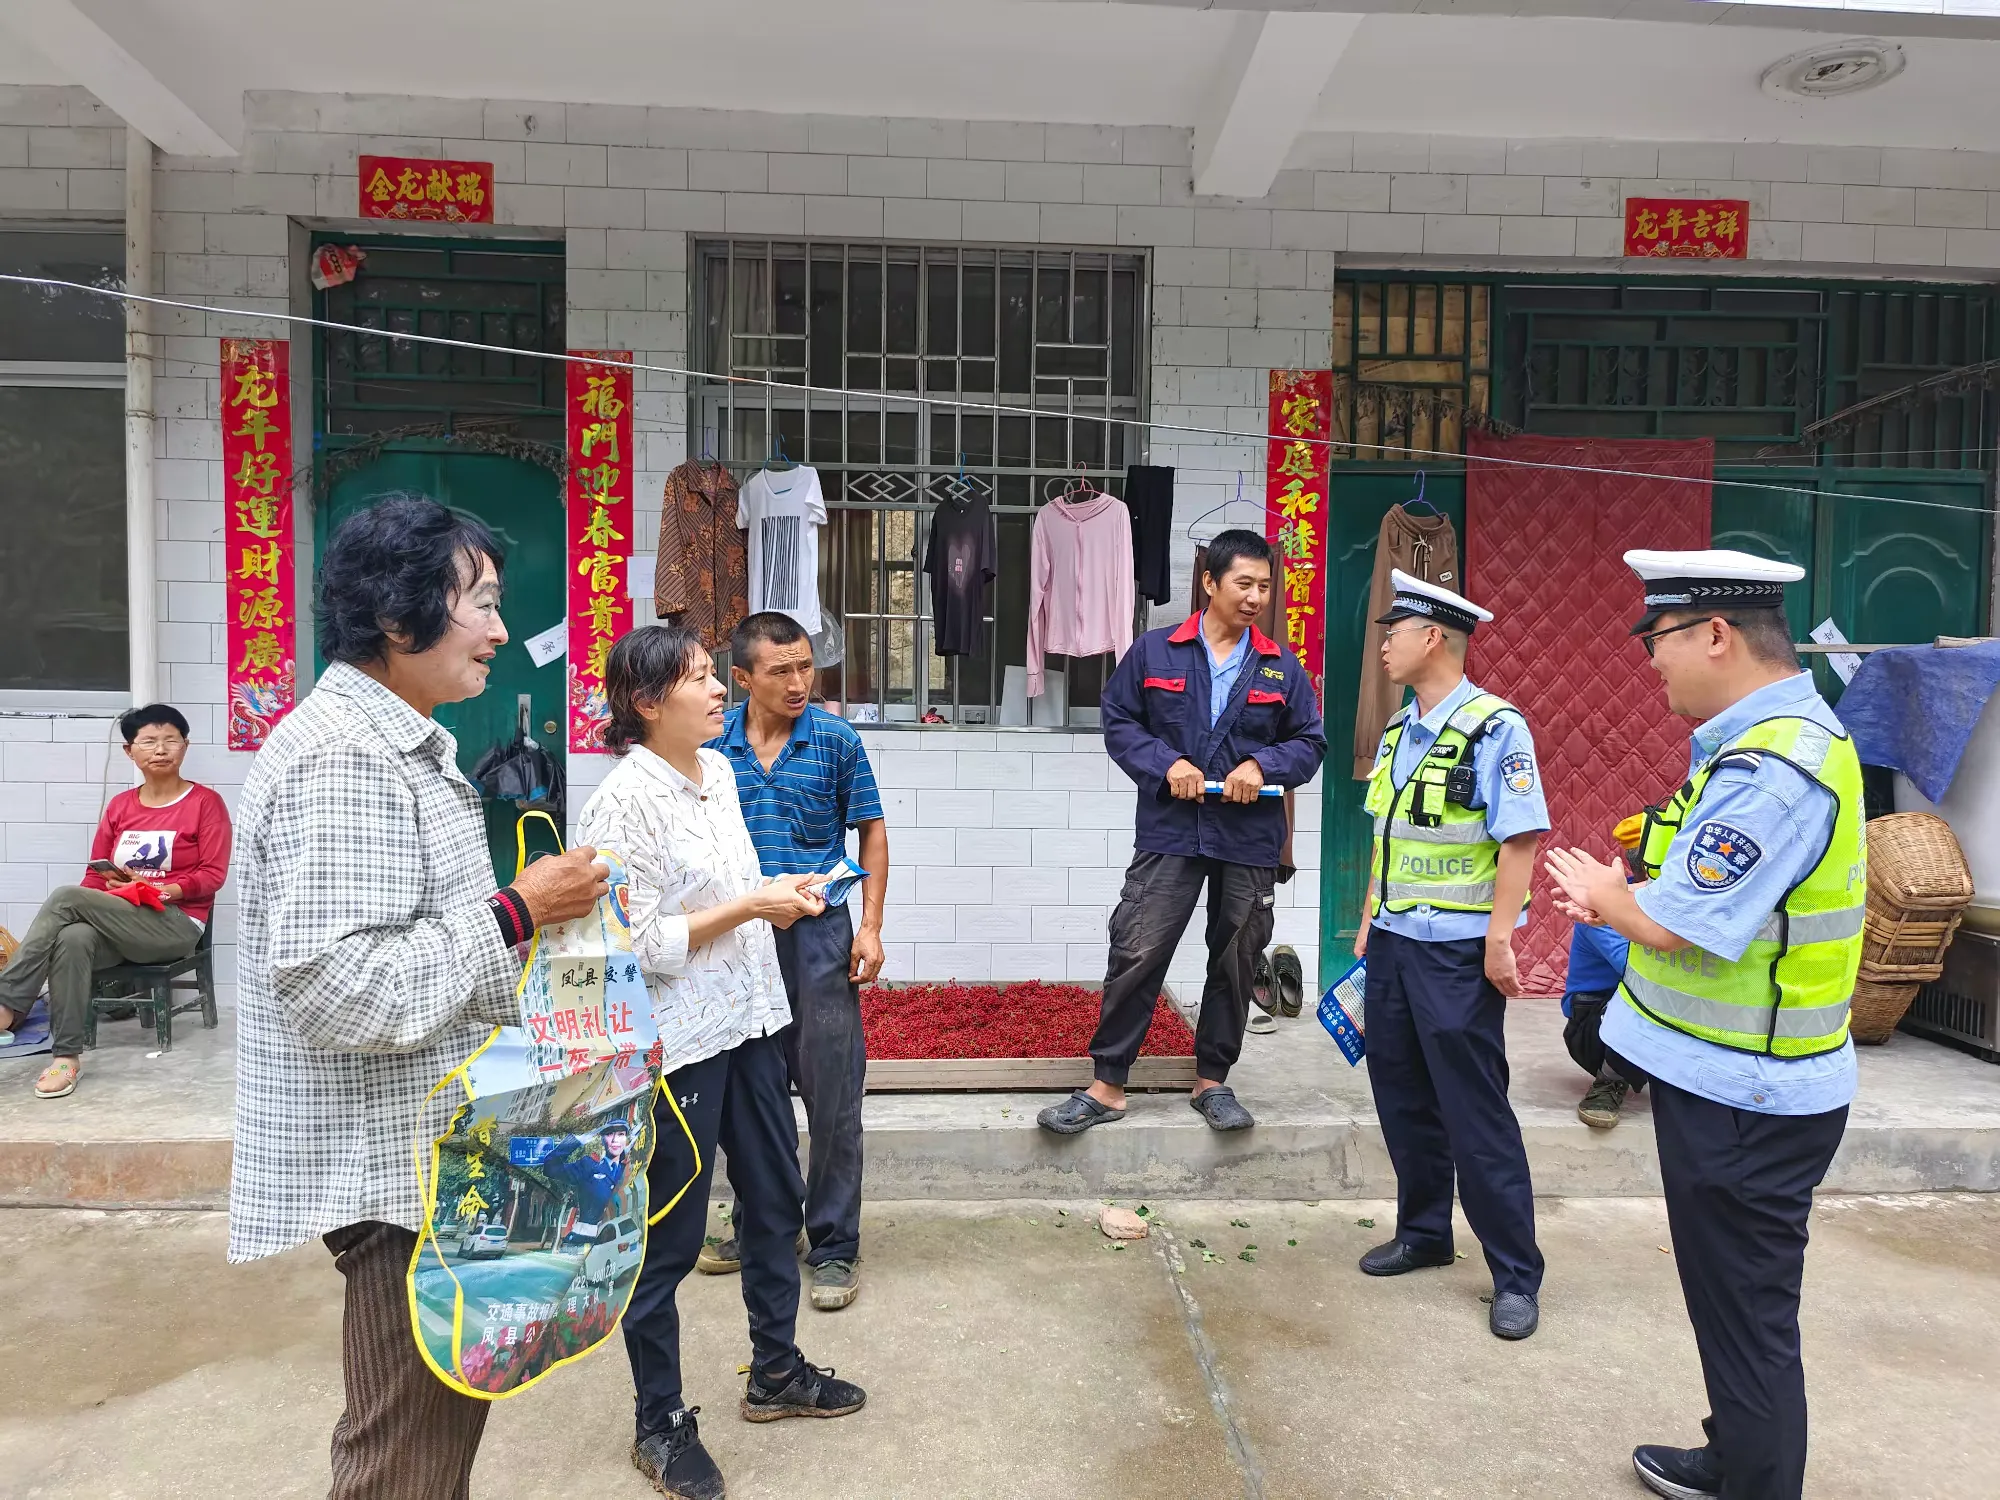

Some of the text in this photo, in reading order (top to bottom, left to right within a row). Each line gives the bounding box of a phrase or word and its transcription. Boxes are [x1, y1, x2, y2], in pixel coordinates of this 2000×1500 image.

[365, 167, 485, 206] 金龙献瑞
[1632, 207, 1740, 243] 龙年吉祥
[1700, 833, 1750, 867] 警 察
[1705, 824, 1759, 859] 中华人民共和国
[1400, 853, 1474, 875] POLICE
[561, 963, 638, 988] 凤县交警
[527, 1001, 634, 1044] 文明礼让
